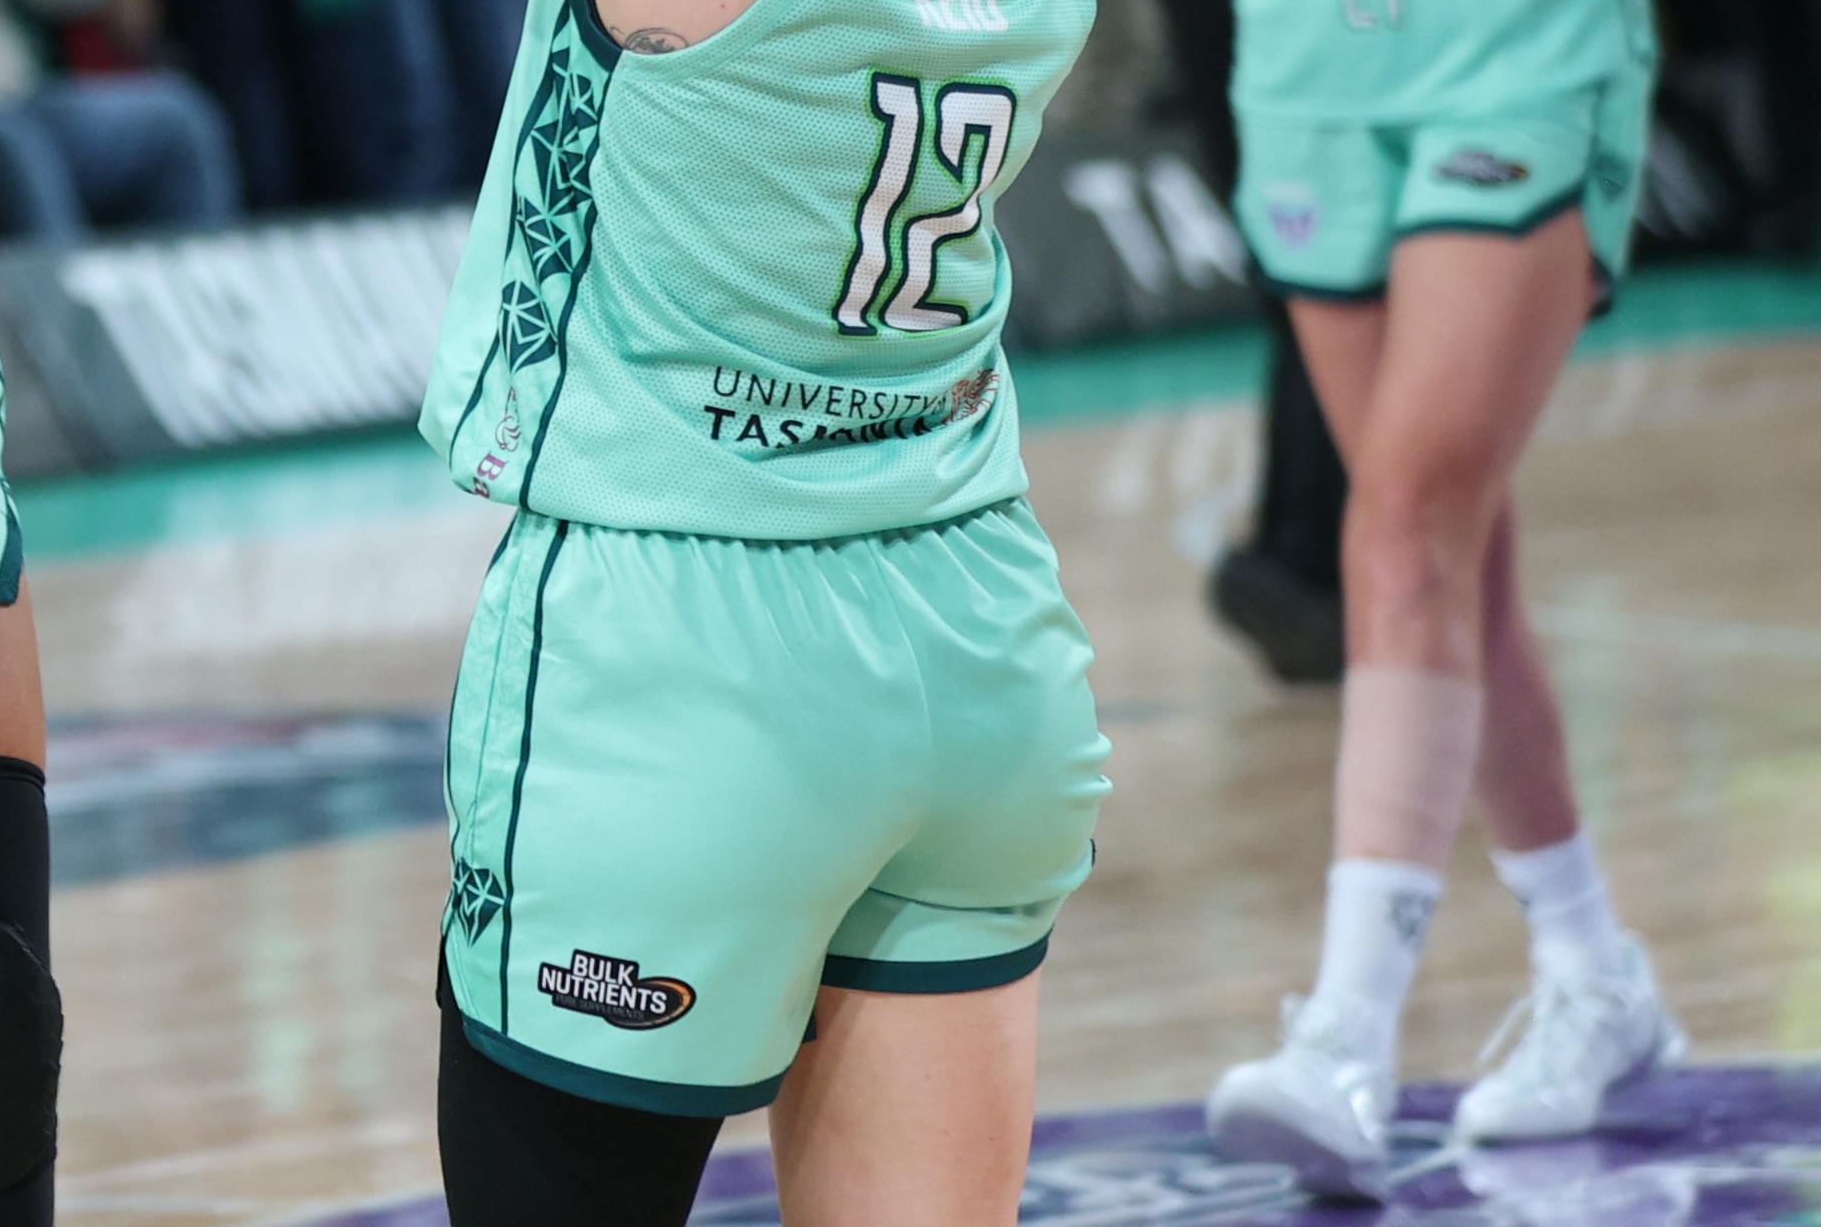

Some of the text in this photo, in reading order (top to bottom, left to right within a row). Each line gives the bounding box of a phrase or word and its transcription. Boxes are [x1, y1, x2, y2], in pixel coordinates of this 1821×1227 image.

[832, 71, 1017, 337] 12
[713, 366, 938, 420] UNIVERSITY
[541, 967, 668, 1014] NUTRIENTS
[572, 953, 635, 987] BULK
